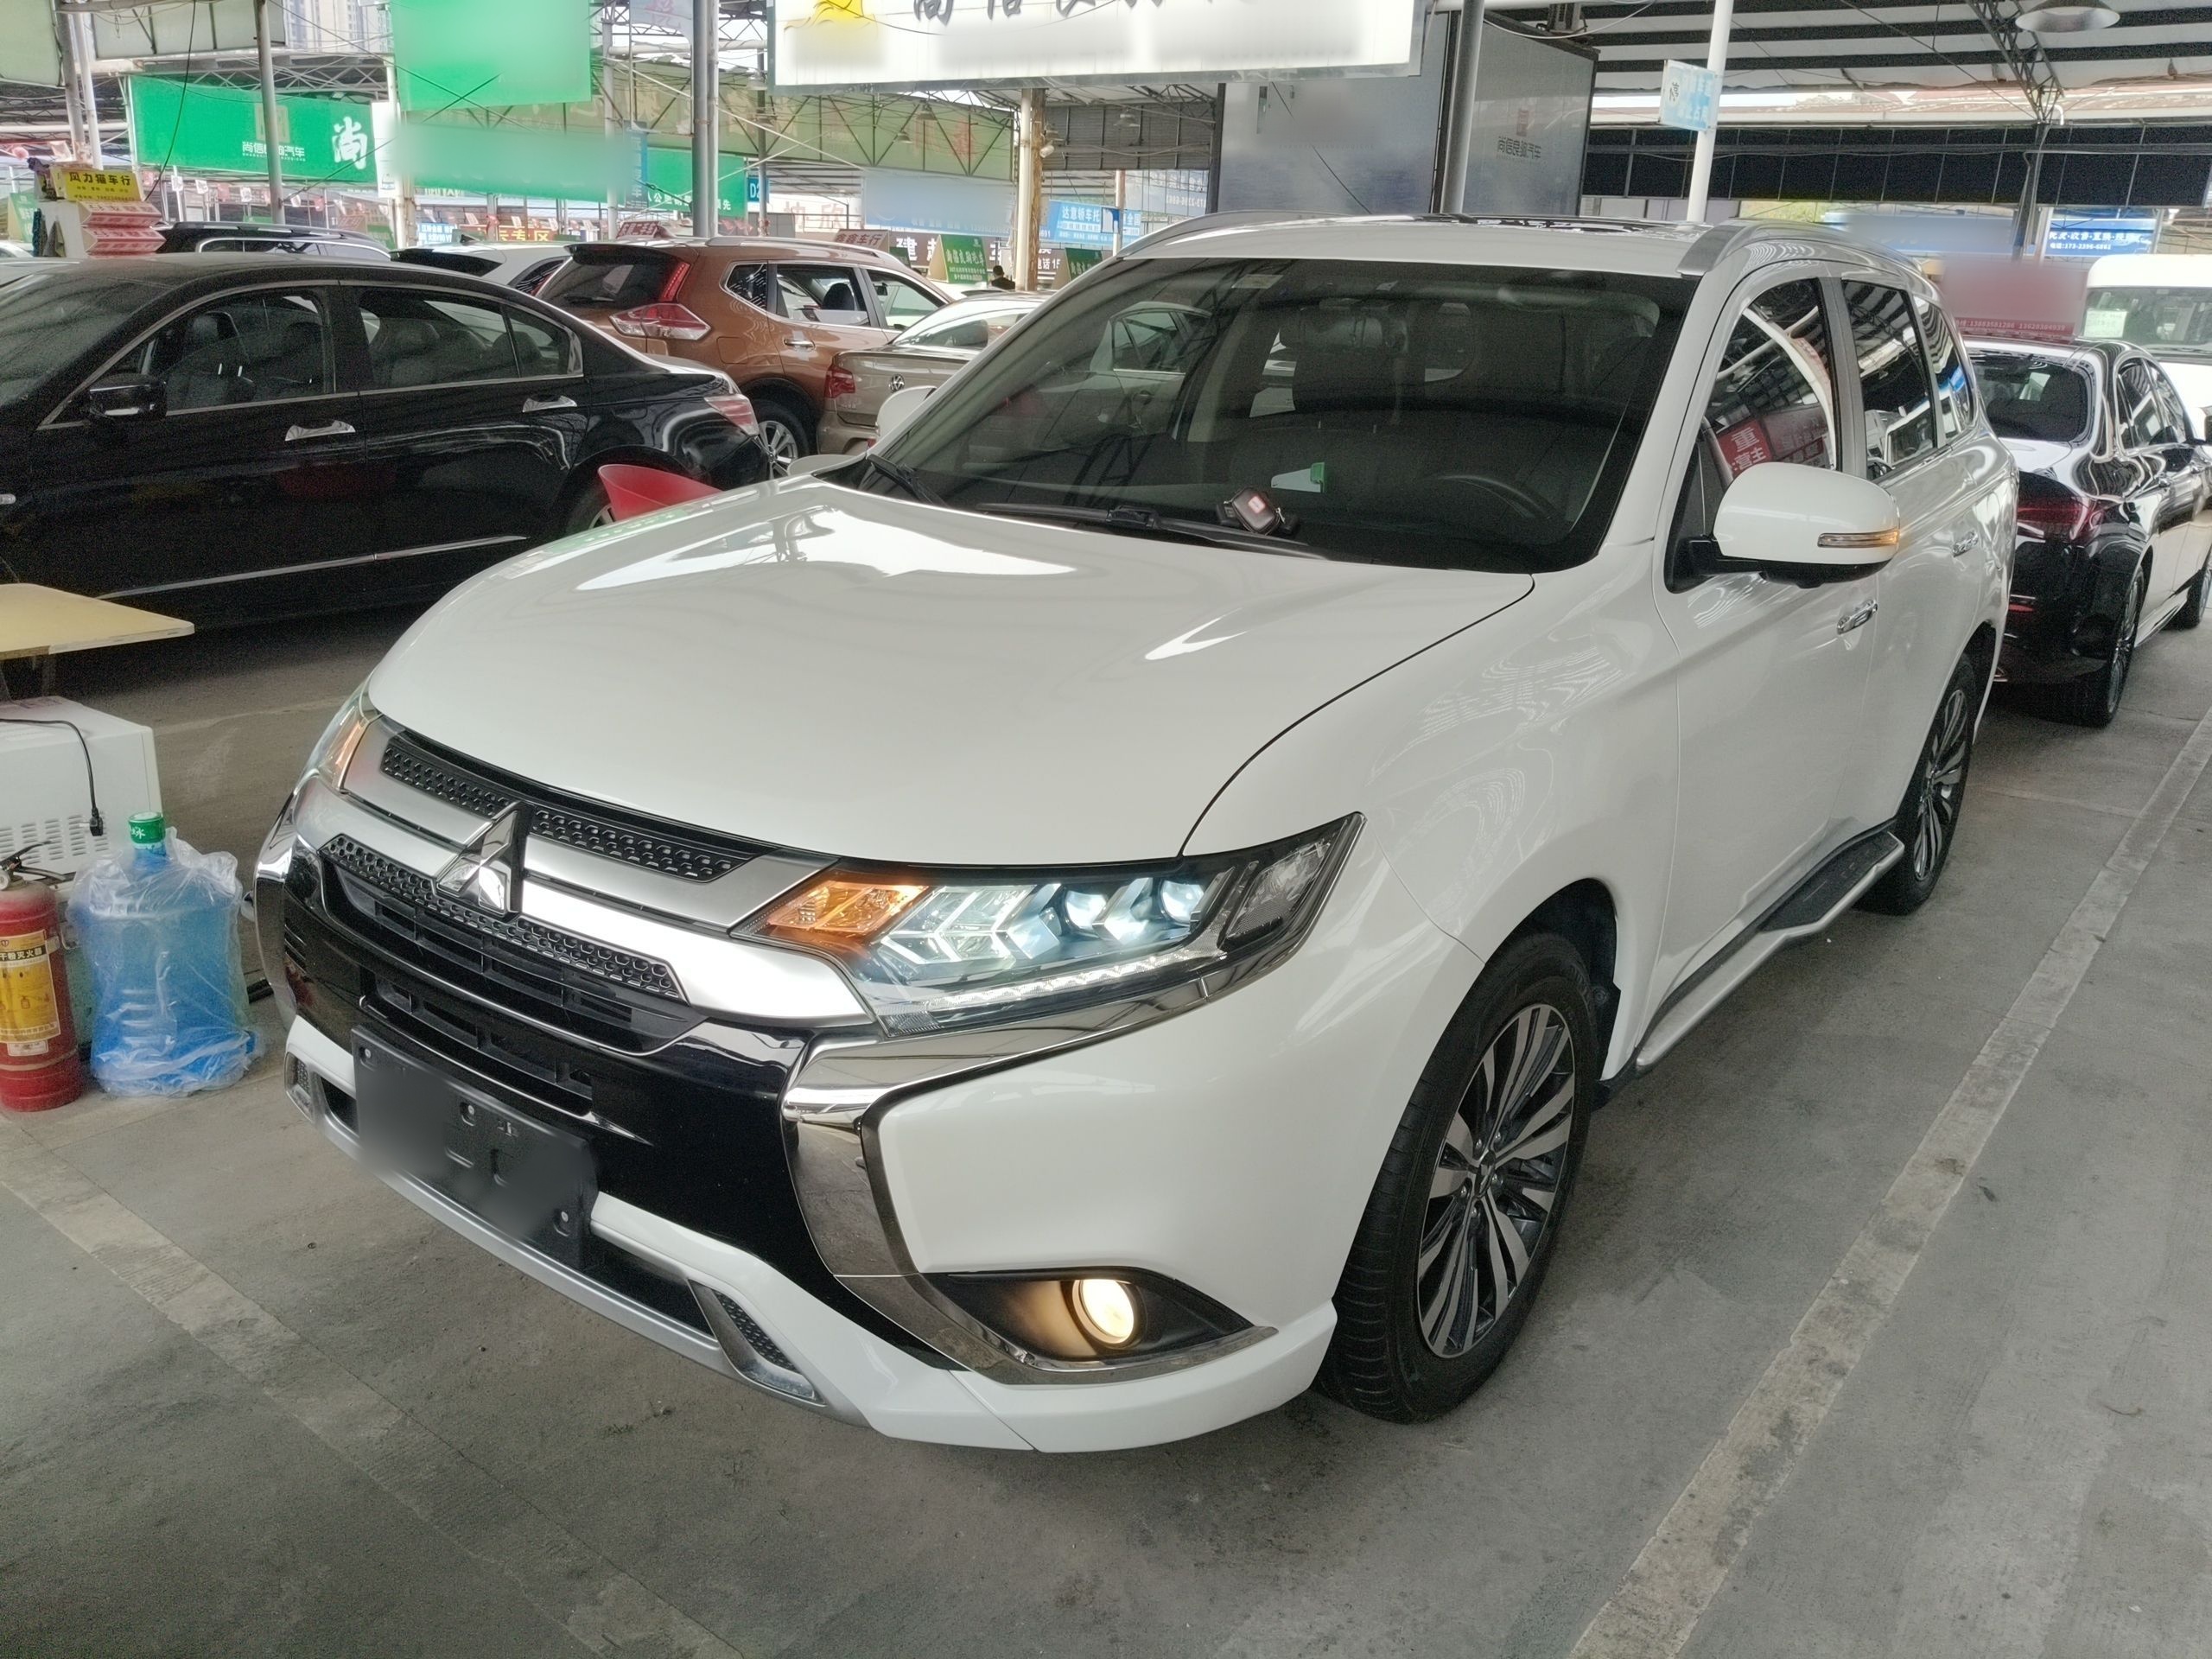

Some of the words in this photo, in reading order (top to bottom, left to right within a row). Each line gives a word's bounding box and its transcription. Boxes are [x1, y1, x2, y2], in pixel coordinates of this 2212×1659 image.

[242, 142, 305, 157] 尚信汽车
[332, 116, 367, 169] 尚
[69, 171, 131, 186] 风力猫车行
